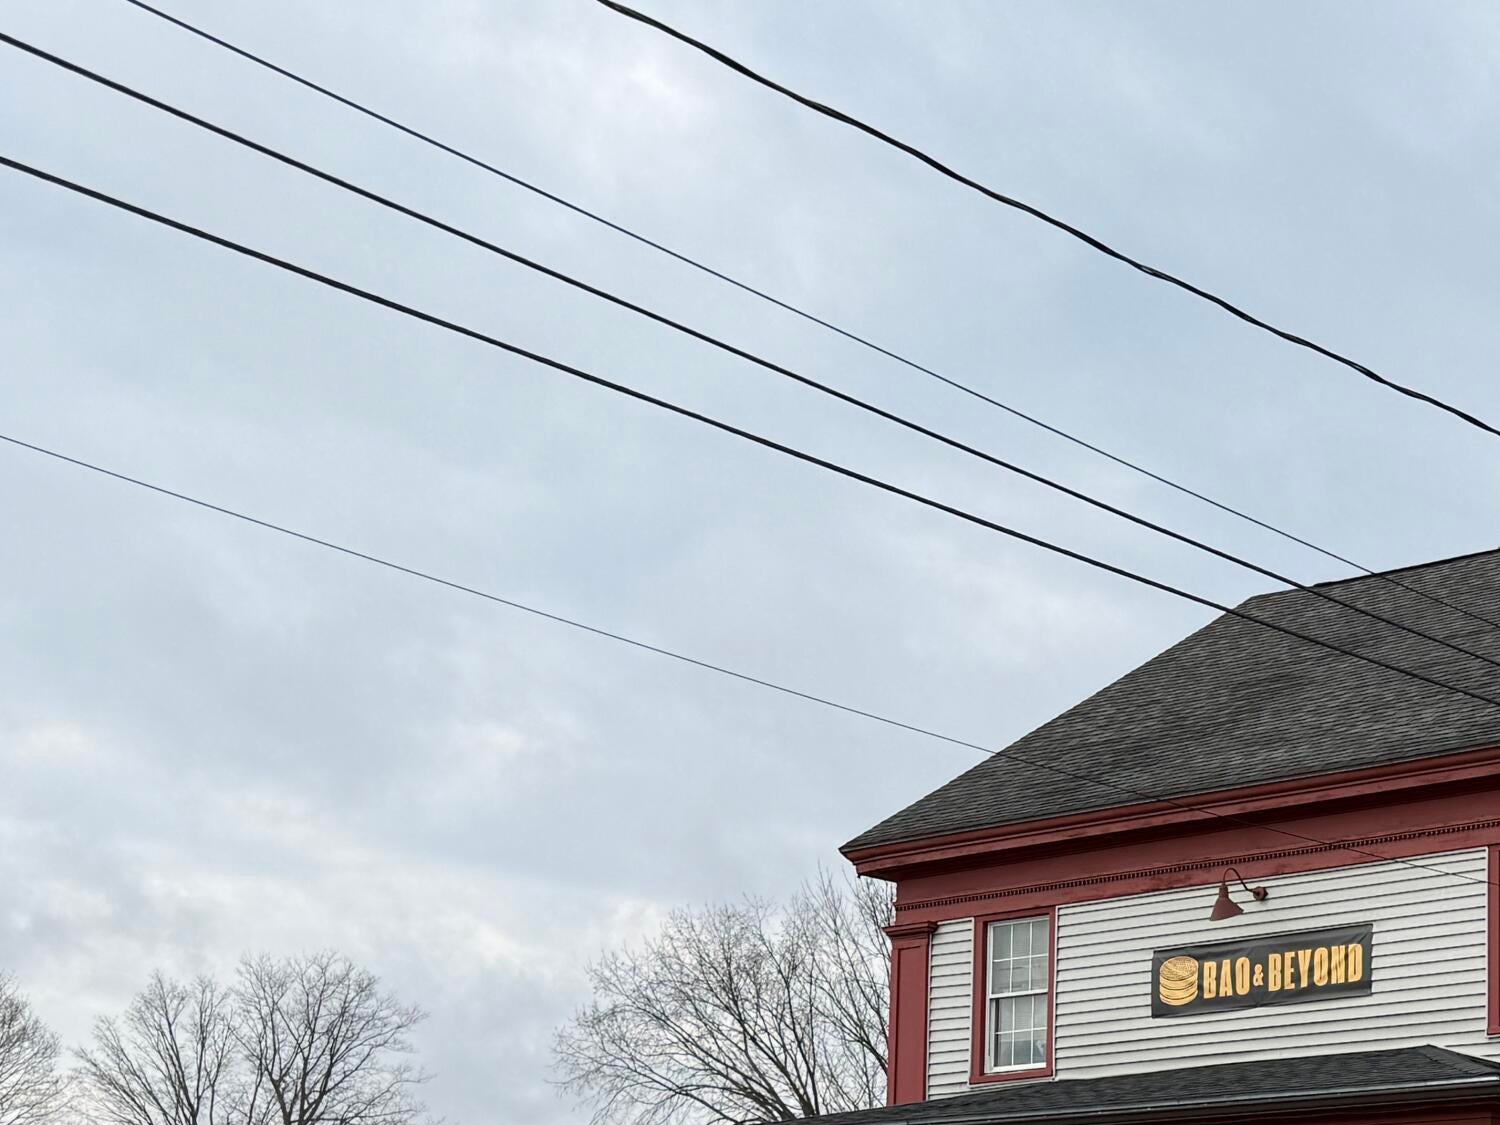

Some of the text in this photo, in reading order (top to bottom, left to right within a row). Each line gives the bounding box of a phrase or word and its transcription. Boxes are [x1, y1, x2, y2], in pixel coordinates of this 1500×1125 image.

[1203, 943, 1363, 999] BAO & BEYOND
